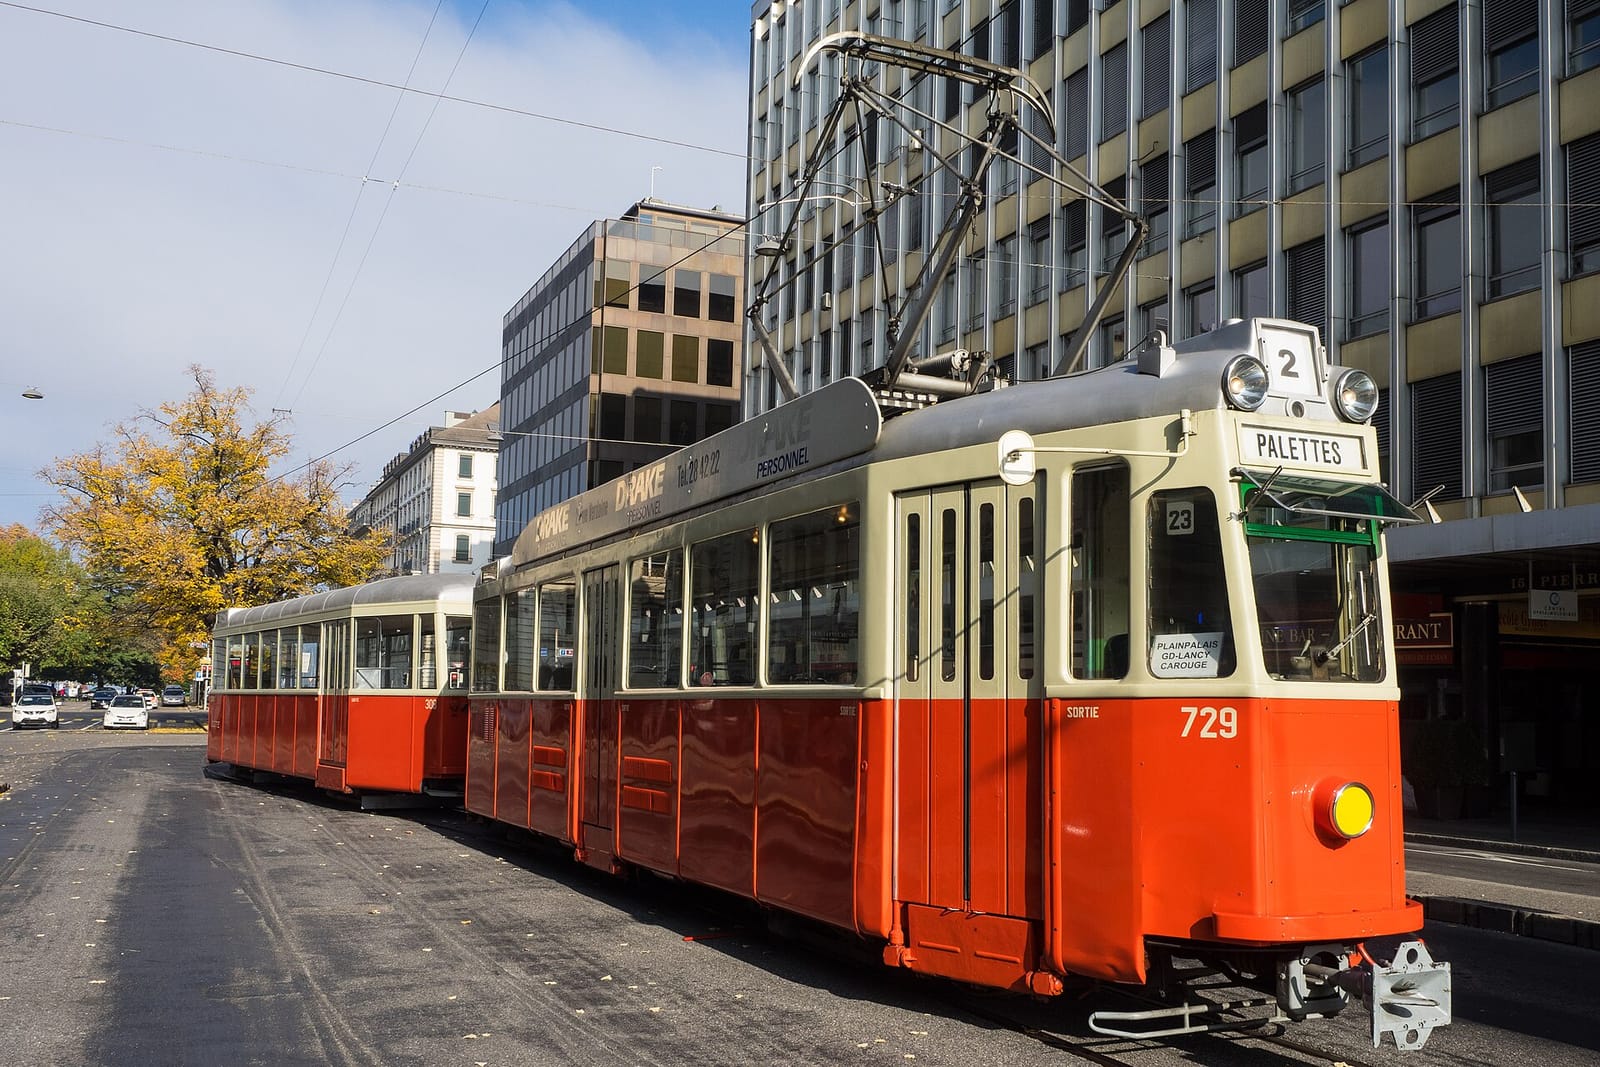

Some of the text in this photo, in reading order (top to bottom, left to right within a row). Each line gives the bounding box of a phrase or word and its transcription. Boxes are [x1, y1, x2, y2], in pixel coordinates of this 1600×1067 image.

[1277, 348, 1300, 379] 2
[1256, 433, 1342, 465] PALETTES
[688, 459, 699, 485] 28
[699, 455, 710, 480] 42
[709, 449, 721, 476] 22
[756, 446, 810, 480] PERSONNEL
[614, 463, 667, 512] DRAKE
[1168, 509, 1192, 530] 23
[1540, 572, 1600, 588] PIERR
[1290, 627, 1316, 642] BAR
[1395, 622, 1442, 641] RANT
[1156, 640, 1219, 650] PLAINPALAIS
[1161, 651, 1211, 660] GD-LANCY
[1160, 660, 1208, 670] CAROUGE
[1066, 706, 1100, 719] SORTIE
[1180, 706, 1238, 739] 729
